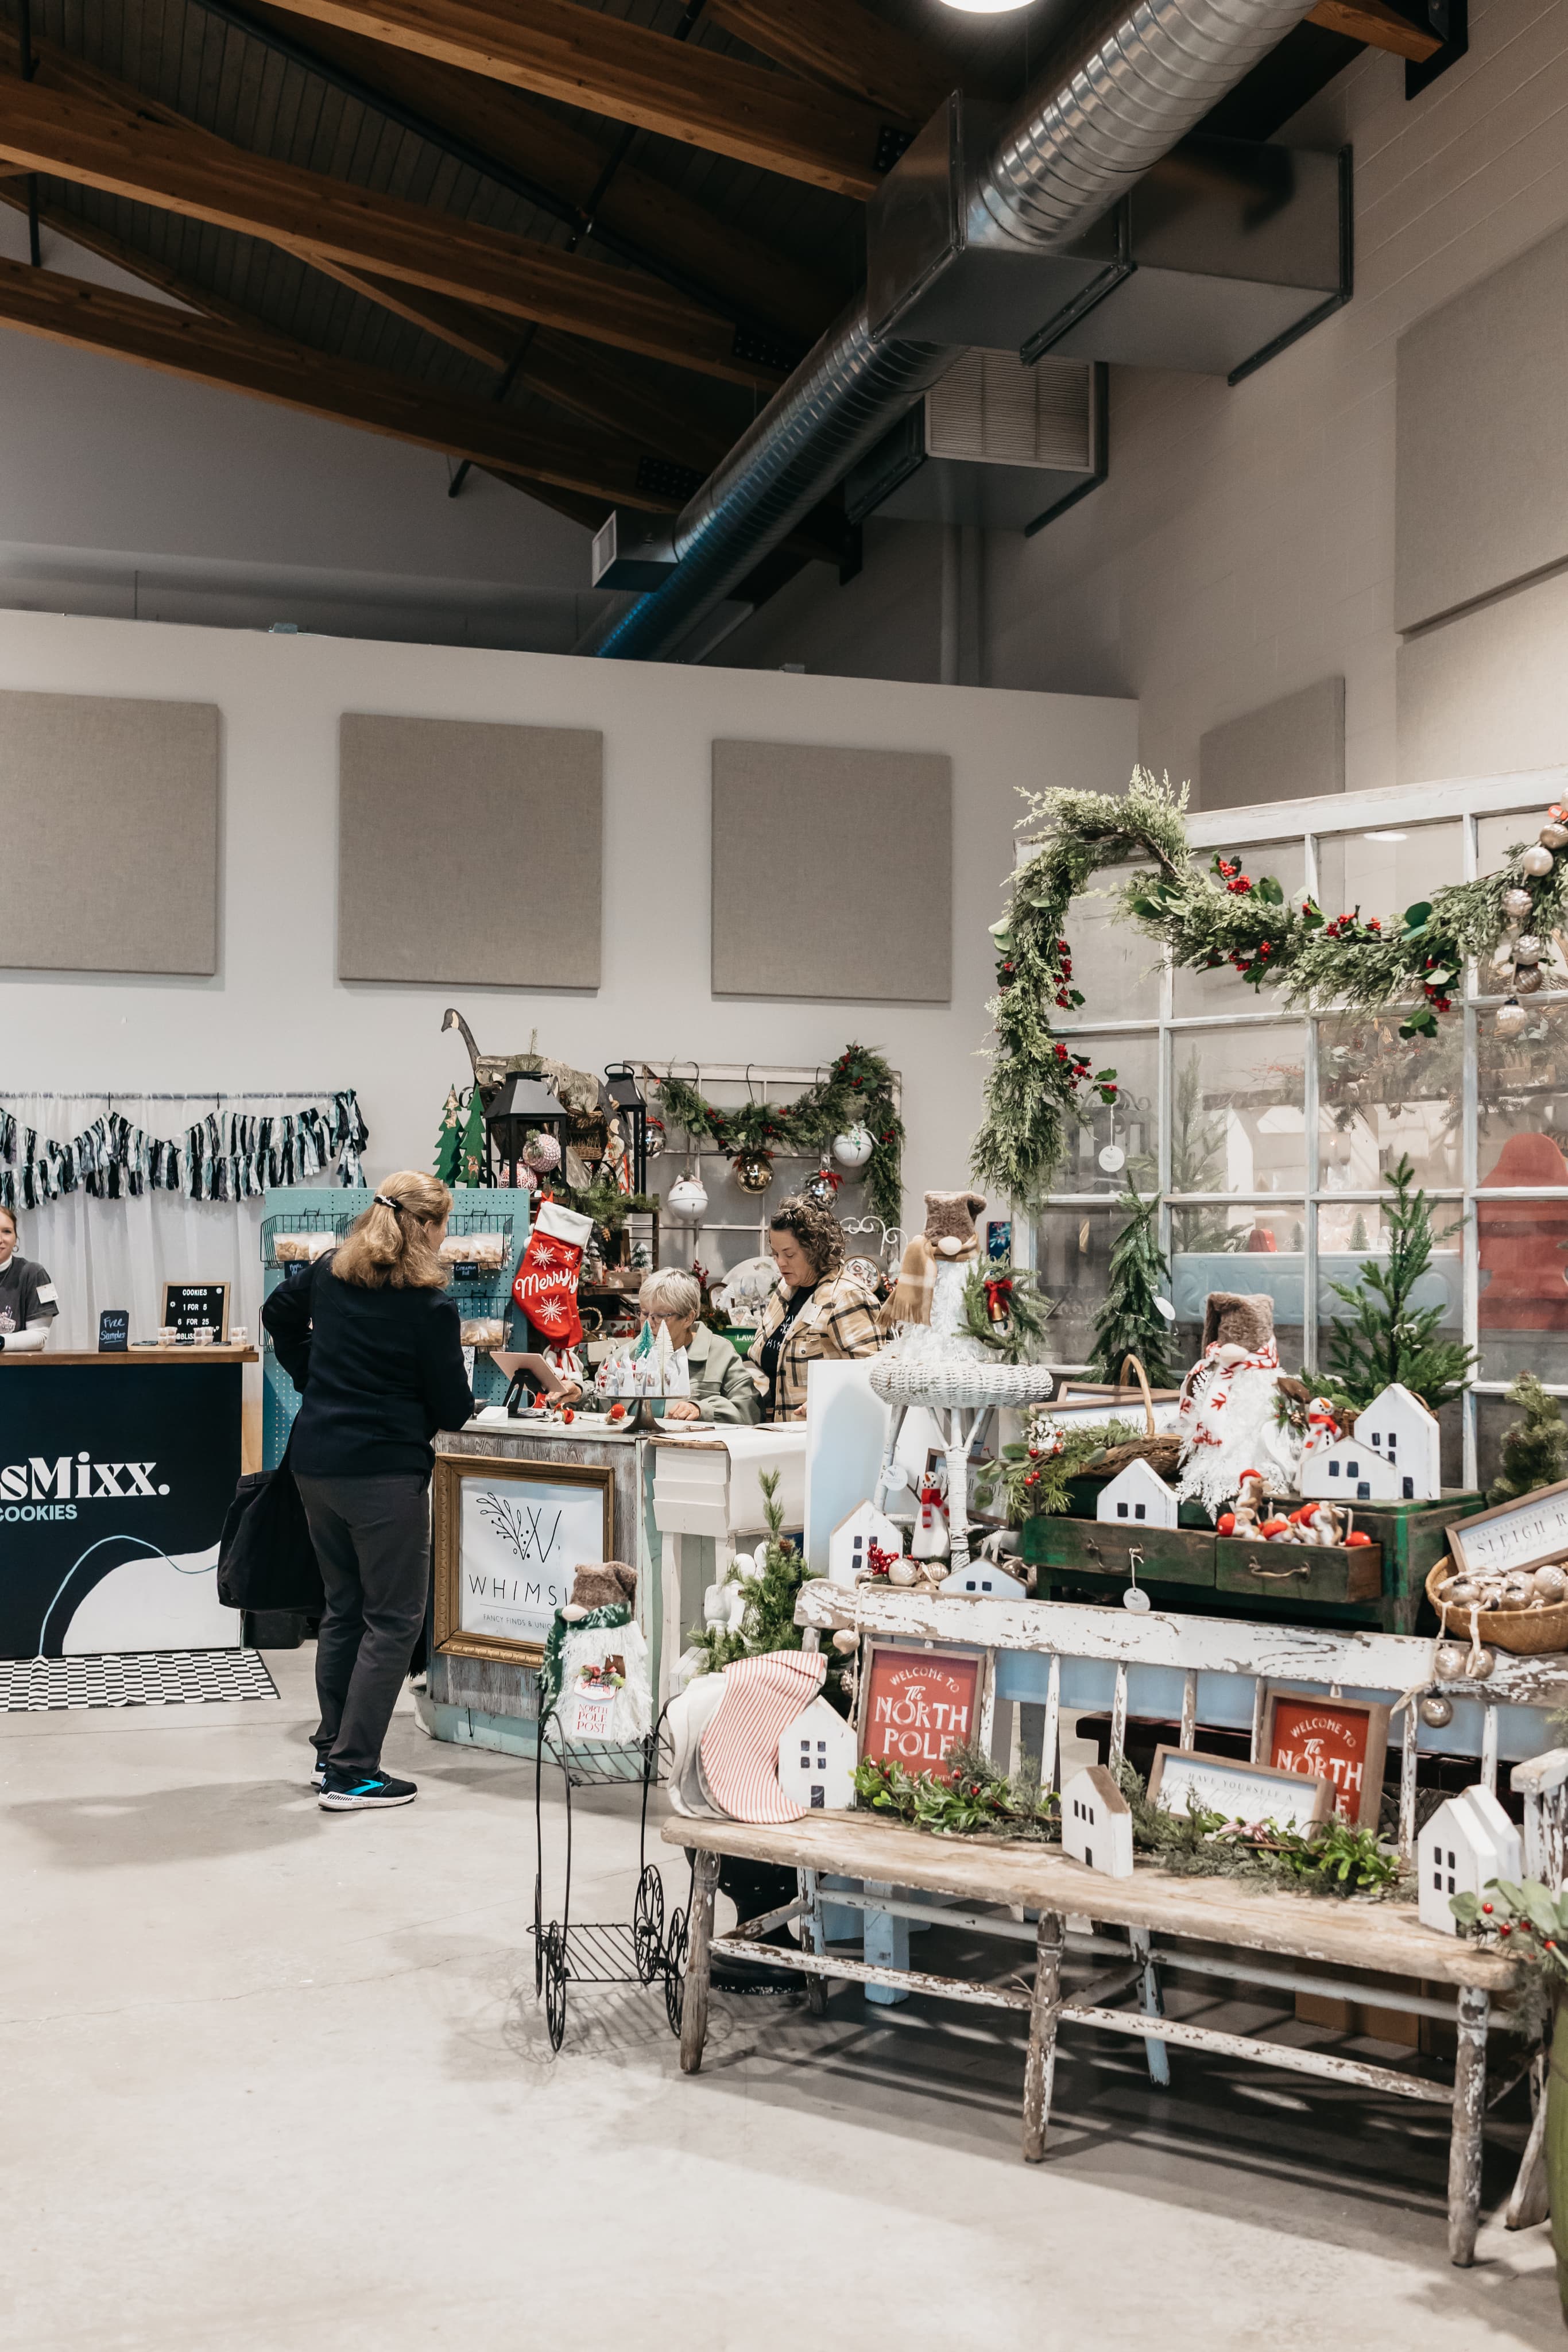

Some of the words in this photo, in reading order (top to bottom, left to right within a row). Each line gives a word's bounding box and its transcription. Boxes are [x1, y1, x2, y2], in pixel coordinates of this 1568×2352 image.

[515, 1268, 572, 1299] Merry
[103, 1316, 125, 1328] Free
[100, 1329, 126, 1341] Samples
[0, 1504, 78, 1522] OOKIES
[1477, 1521, 1546, 1556] SLEIGH
[483, 1613, 504, 1623] FANCY
[506, 1617, 526, 1626] FINDS
[889, 1667, 944, 1686] WELCOME
[946, 1677, 959, 1693] TO
[905, 1685, 926, 1703] The
[578, 1711, 607, 1723] POLE
[579, 1704, 608, 1714] NORTH
[874, 1696, 968, 1732] NORTH
[577, 1721, 607, 1733] POST
[1290, 1717, 1342, 1738] WELCOME
[1343, 1730, 1356, 1747] TO
[882, 1728, 955, 1761] POLE
[1304, 1738, 1325, 1756] The
[1277, 1748, 1363, 1792] NORTH
[1188, 1773, 1214, 1785] HAVE
[1223, 1780, 1279, 1798] YOURSELF
[1287, 1793, 1292, 1801] A
